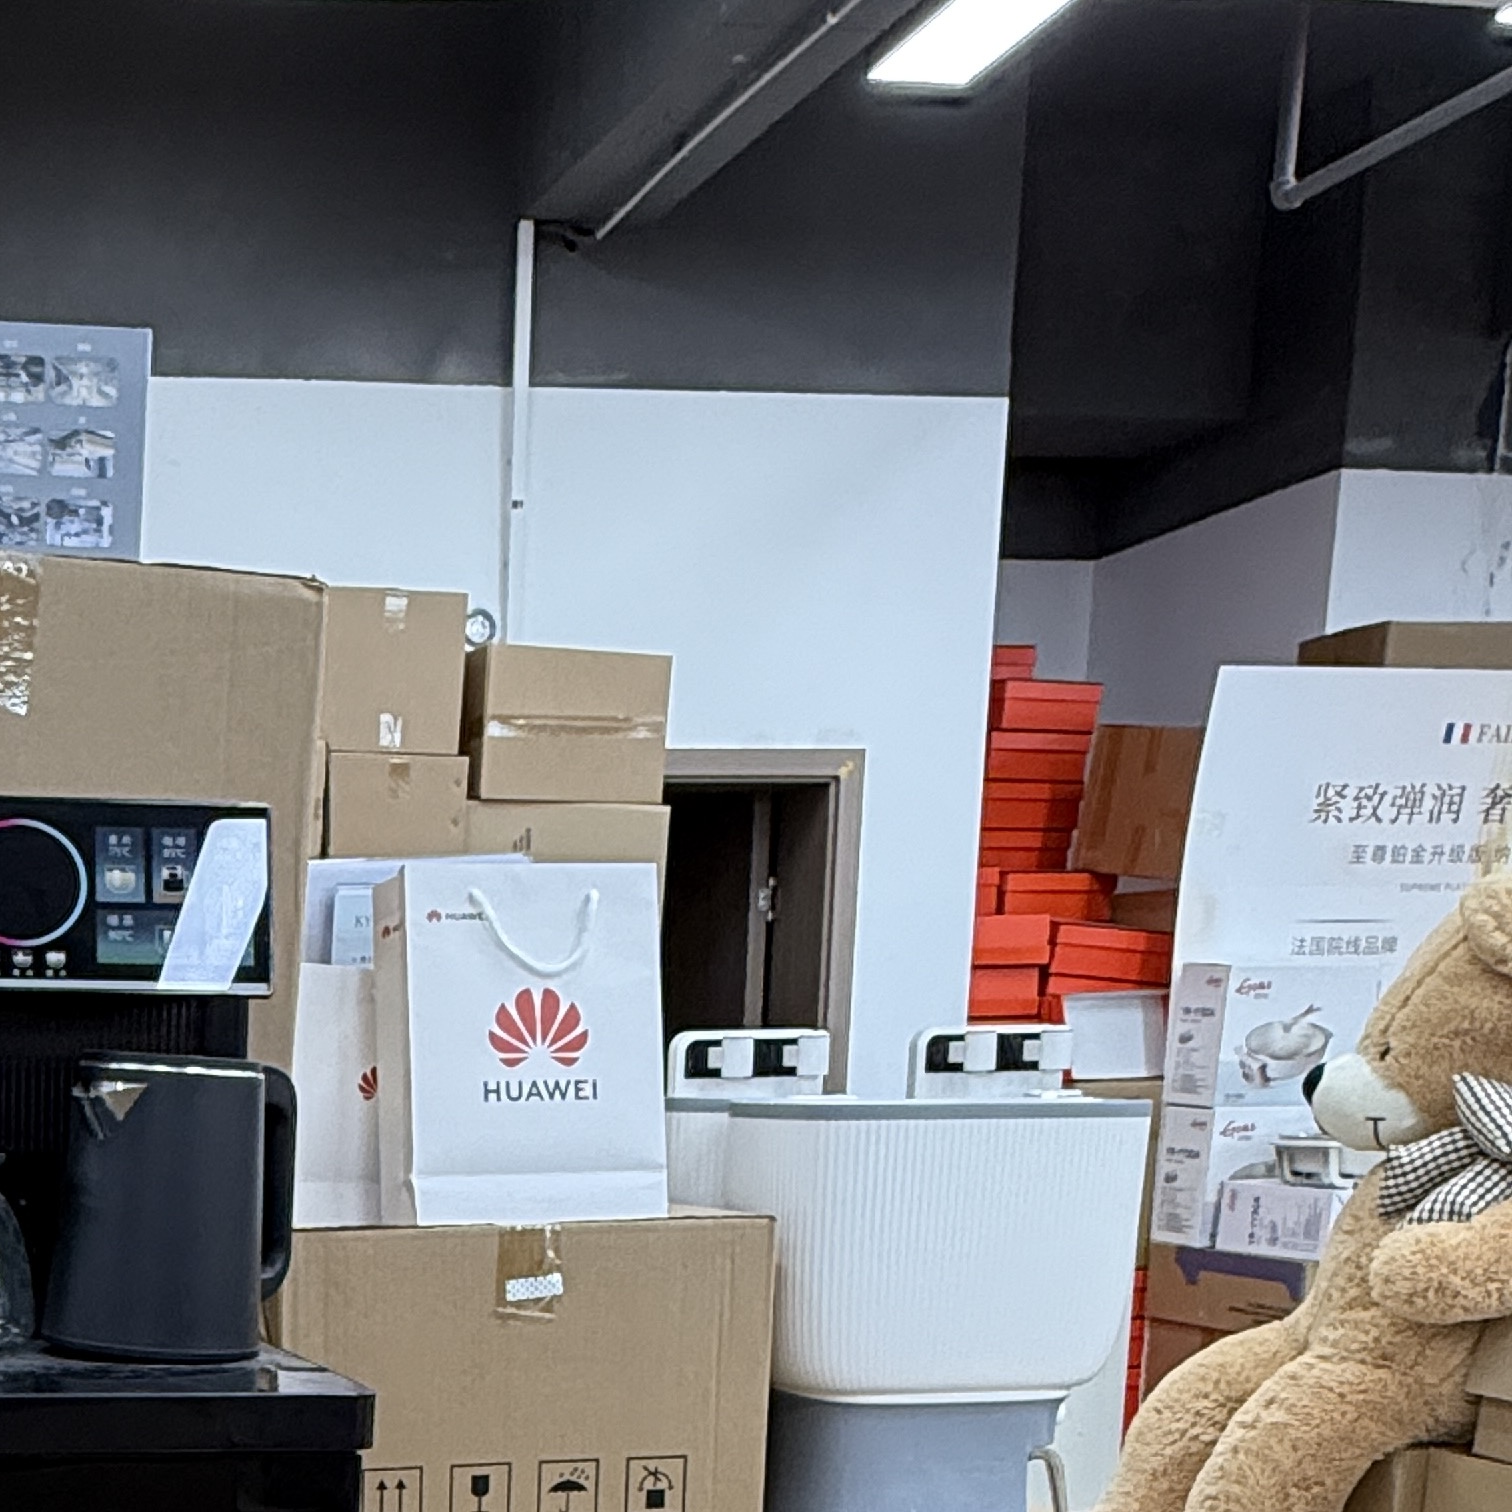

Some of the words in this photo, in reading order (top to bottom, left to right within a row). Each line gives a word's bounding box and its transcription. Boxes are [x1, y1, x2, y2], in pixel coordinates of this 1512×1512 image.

[1311, 781, 1467, 825] 紧致弹润
[1290, 935, 1399, 957] 法国院线品牌
[482, 1079, 598, 1103] HUAWEI
